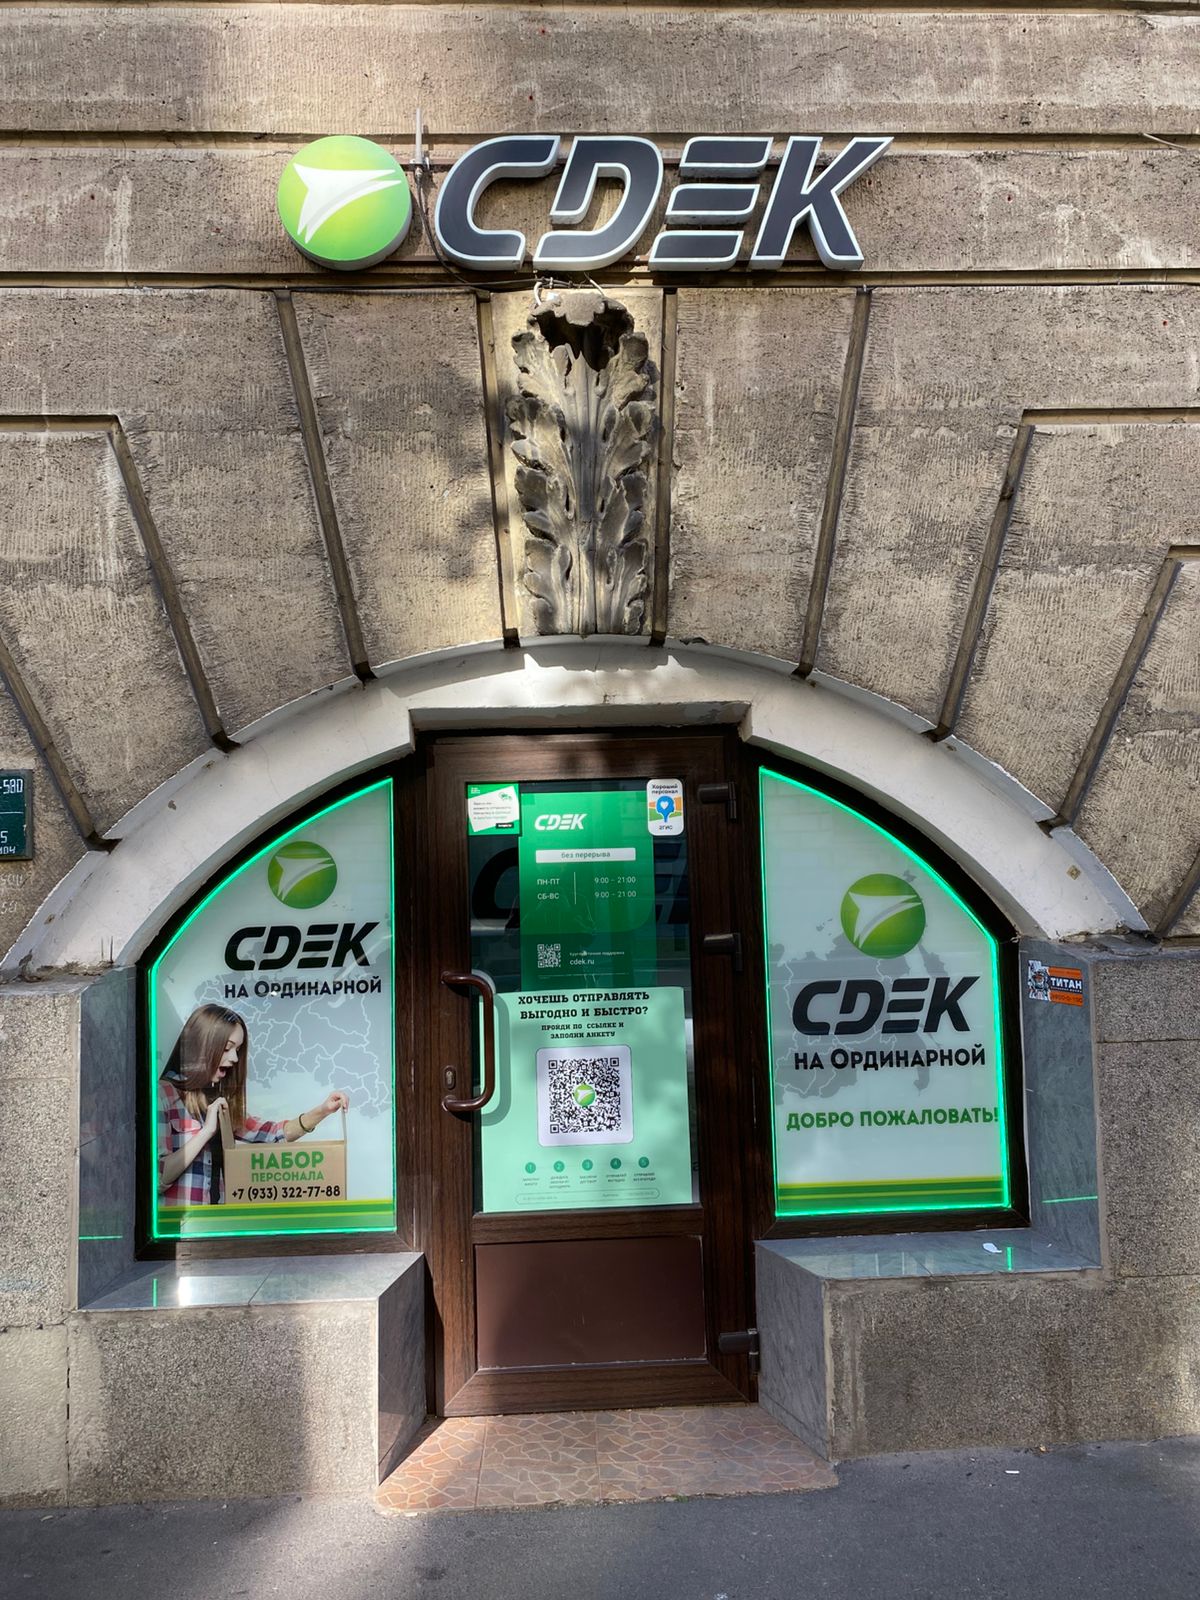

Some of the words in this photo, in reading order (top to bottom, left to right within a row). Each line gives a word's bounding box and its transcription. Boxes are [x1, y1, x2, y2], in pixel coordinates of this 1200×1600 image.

[432, 135, 894, 271] CDEK
[534, 813, 588, 831] CDEK
[575, 851, 611, 860] перерыва
[537, 878, 560, 886] ПН-ПТ
[617, 876, 636, 884] 21:00
[537, 892, 560, 900] СБ-ВС
[225, 922, 380, 972] CDEK
[569, 958, 595, 966] cdek.ru
[1050, 977, 1083, 990] ТИТАН
[224, 984, 249, 999] НА
[518, 995, 569, 1005] ХОЧЕШЬ
[572, 991, 650, 1003] ОТПРАВЛЯТЬ
[520, 1008, 578, 1020] ВЫГОДНО
[594, 1006, 649, 1017] БЫСТРО?
[792, 976, 980, 1036] CDEK
[794, 1052, 824, 1070] НА
[830, 1043, 986, 1071] ОРДИНАРНОЙ
[786, 1112, 854, 1131] ДОБРО
[859, 1107, 999, 1127] ПОЖАЛОВАТЬ!
[250, 1151, 325, 1170] НАБОР
[251, 1170, 325, 1183] ПЕРСОНАЛА
[231, 1188, 245, 1200] +7
[247, 1185, 278, 1201] (933)
[281, 1185, 341, 1198] 322-77-88
